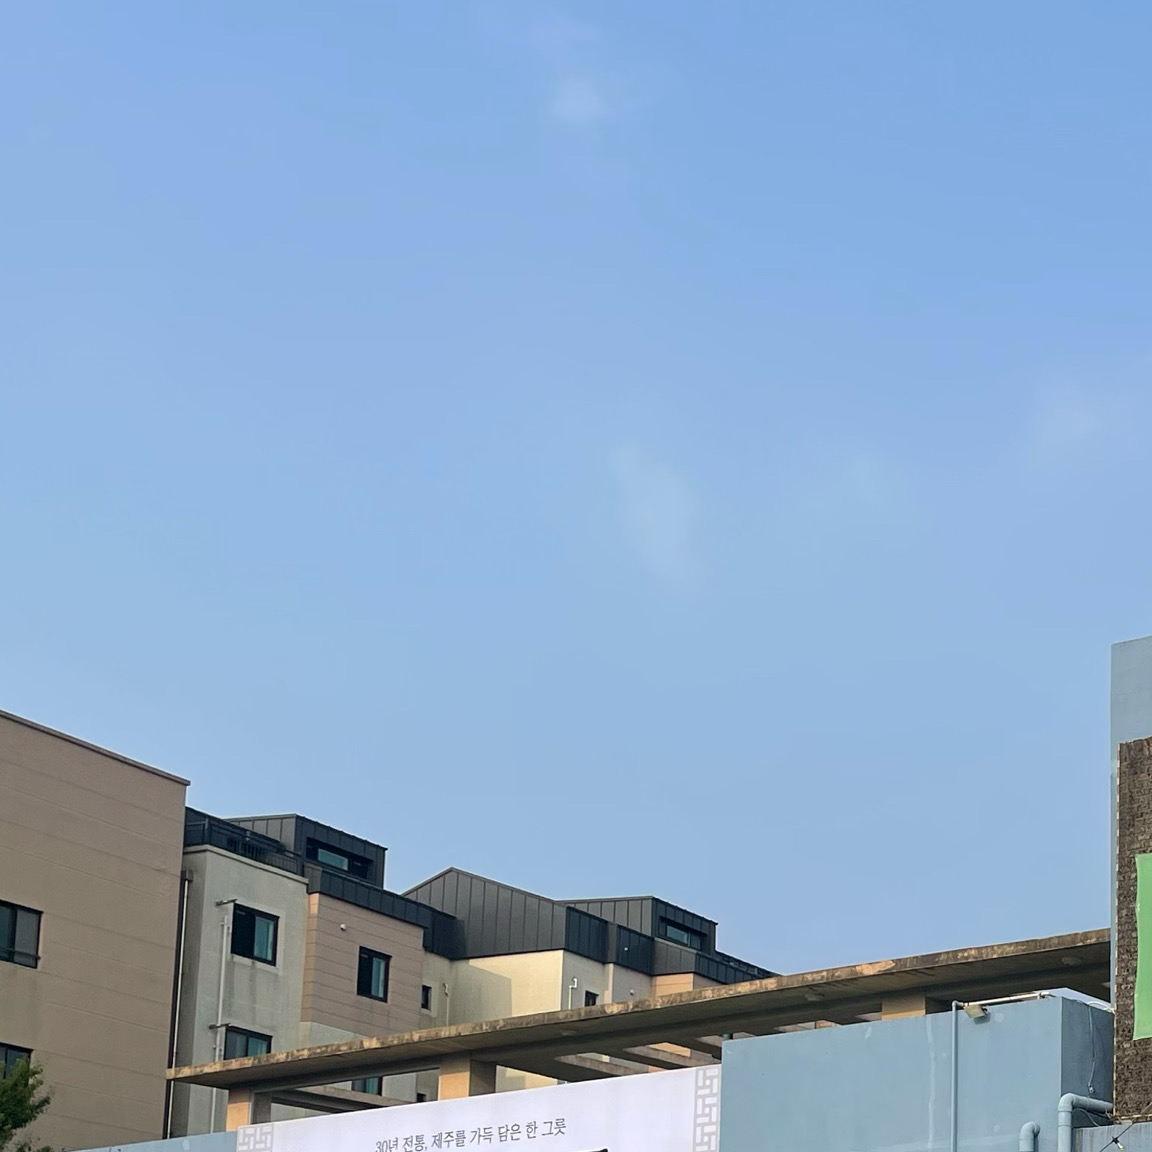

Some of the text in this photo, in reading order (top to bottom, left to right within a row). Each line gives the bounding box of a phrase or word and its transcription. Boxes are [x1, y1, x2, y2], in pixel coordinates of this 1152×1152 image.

[402, 1134, 428, 1152] 전통,
[431, 1130, 466, 1149] 제주를
[469, 1127, 493, 1145] 가득
[498, 1123, 521, 1142] 담은
[526, 1121, 538, 1139] 한
[542, 1118, 567, 1136] 그릇
